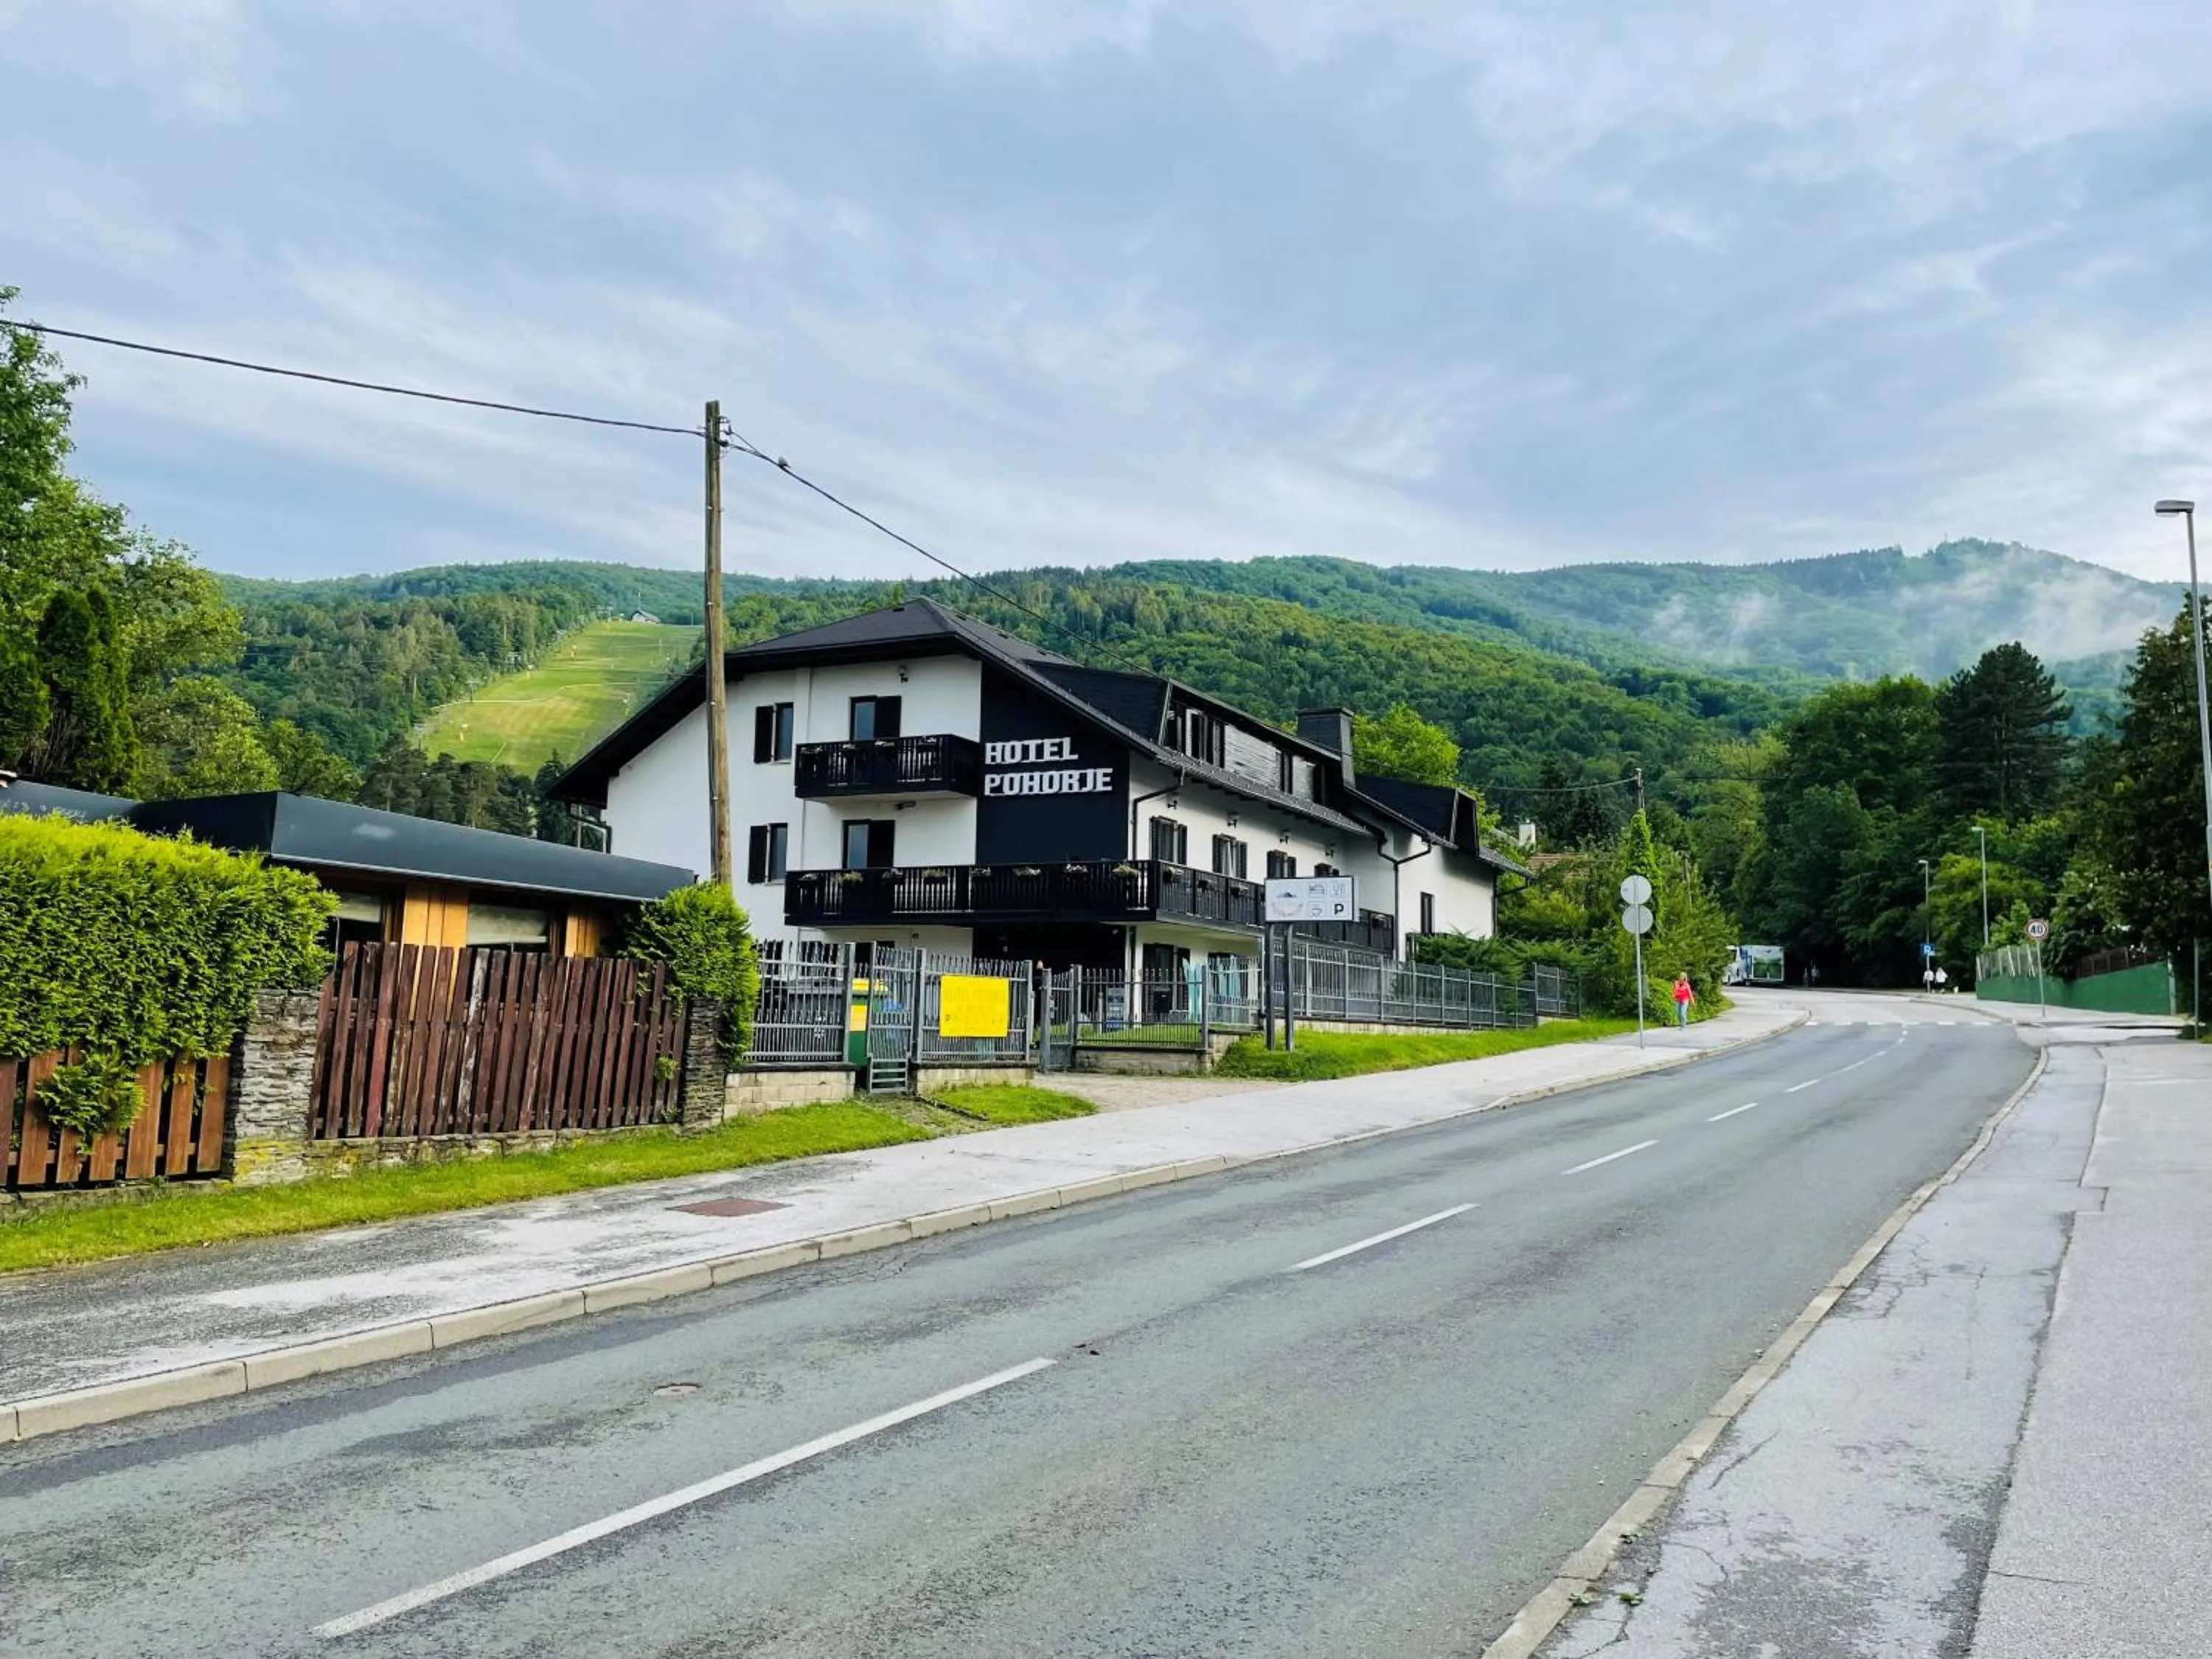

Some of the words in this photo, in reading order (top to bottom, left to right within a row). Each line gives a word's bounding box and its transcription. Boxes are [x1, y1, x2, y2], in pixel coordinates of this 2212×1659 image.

[984, 737, 1079, 765] HOTEL
[984, 768, 1113, 796] POHORJE
[1334, 903, 1344, 915] P
[2030, 925, 2043, 934] 40
